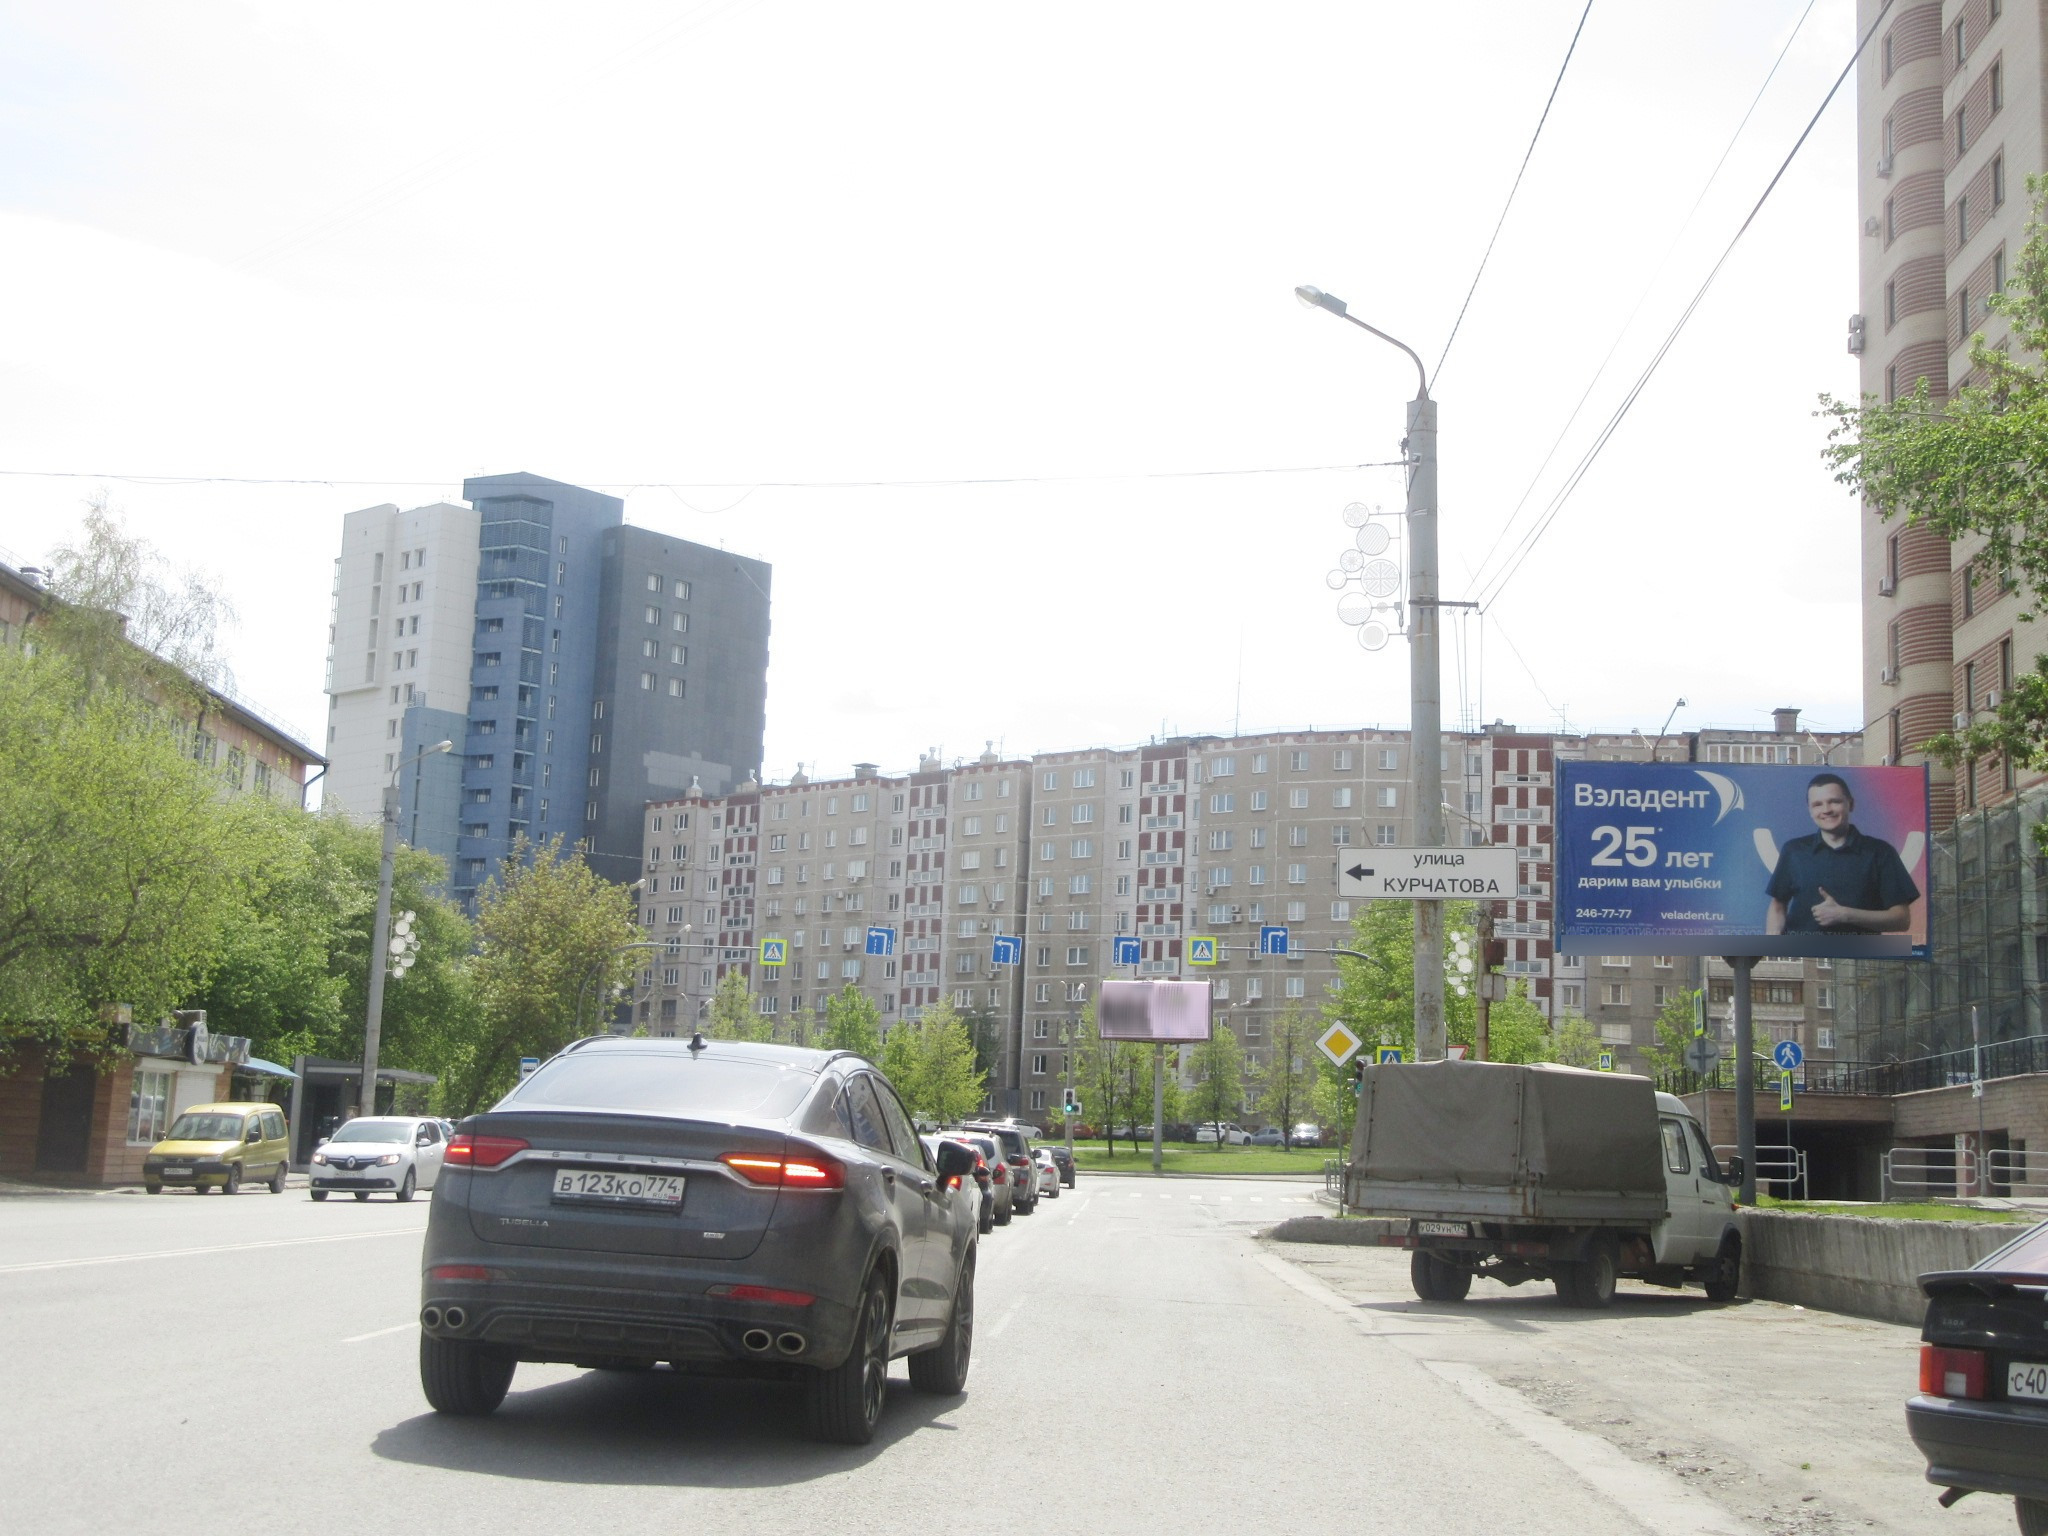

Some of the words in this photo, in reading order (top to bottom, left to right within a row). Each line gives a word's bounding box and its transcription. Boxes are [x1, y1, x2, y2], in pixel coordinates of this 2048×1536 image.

[1574, 783, 1710, 812] Вэладент
[1413, 854, 1465, 868] улица
[1665, 851, 1714, 868] лет
[1384, 878, 1500, 893] КУРЧАТОВА
[1578, 877, 1628, 889] дарим
[1631, 878, 1661, 888] вам
[1664, 877, 1722, 891] улыбки
[1575, 908, 1632, 919] 246-77-77
[1660, 910, 1724, 921] veladent.ru
[552, 1151, 689, 1166] GEELY
